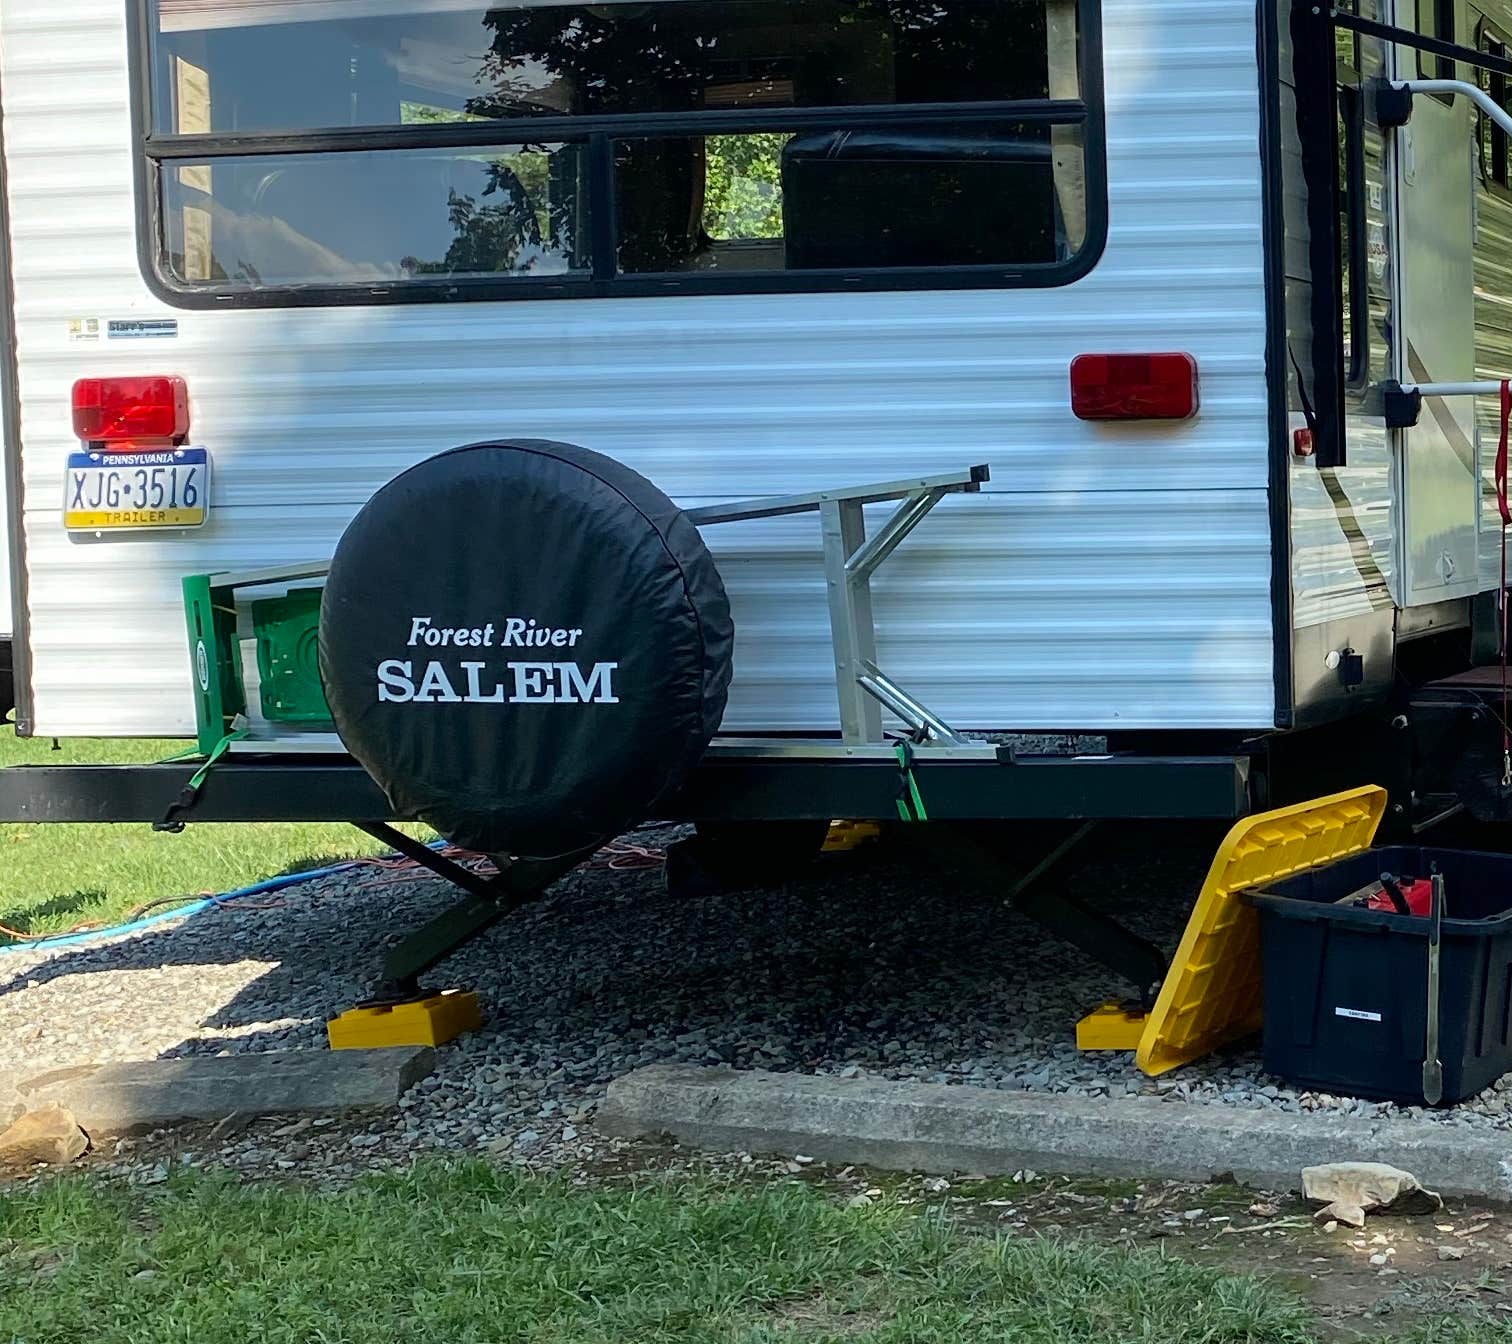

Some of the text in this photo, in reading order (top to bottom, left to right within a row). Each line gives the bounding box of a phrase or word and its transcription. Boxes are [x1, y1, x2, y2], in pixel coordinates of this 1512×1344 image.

[102, 453, 174, 465] PENNSYLVANIA
[104, 511, 166, 524] TRAILER
[406, 616, 582, 647] Forest River
[377, 659, 620, 703] SALEM
